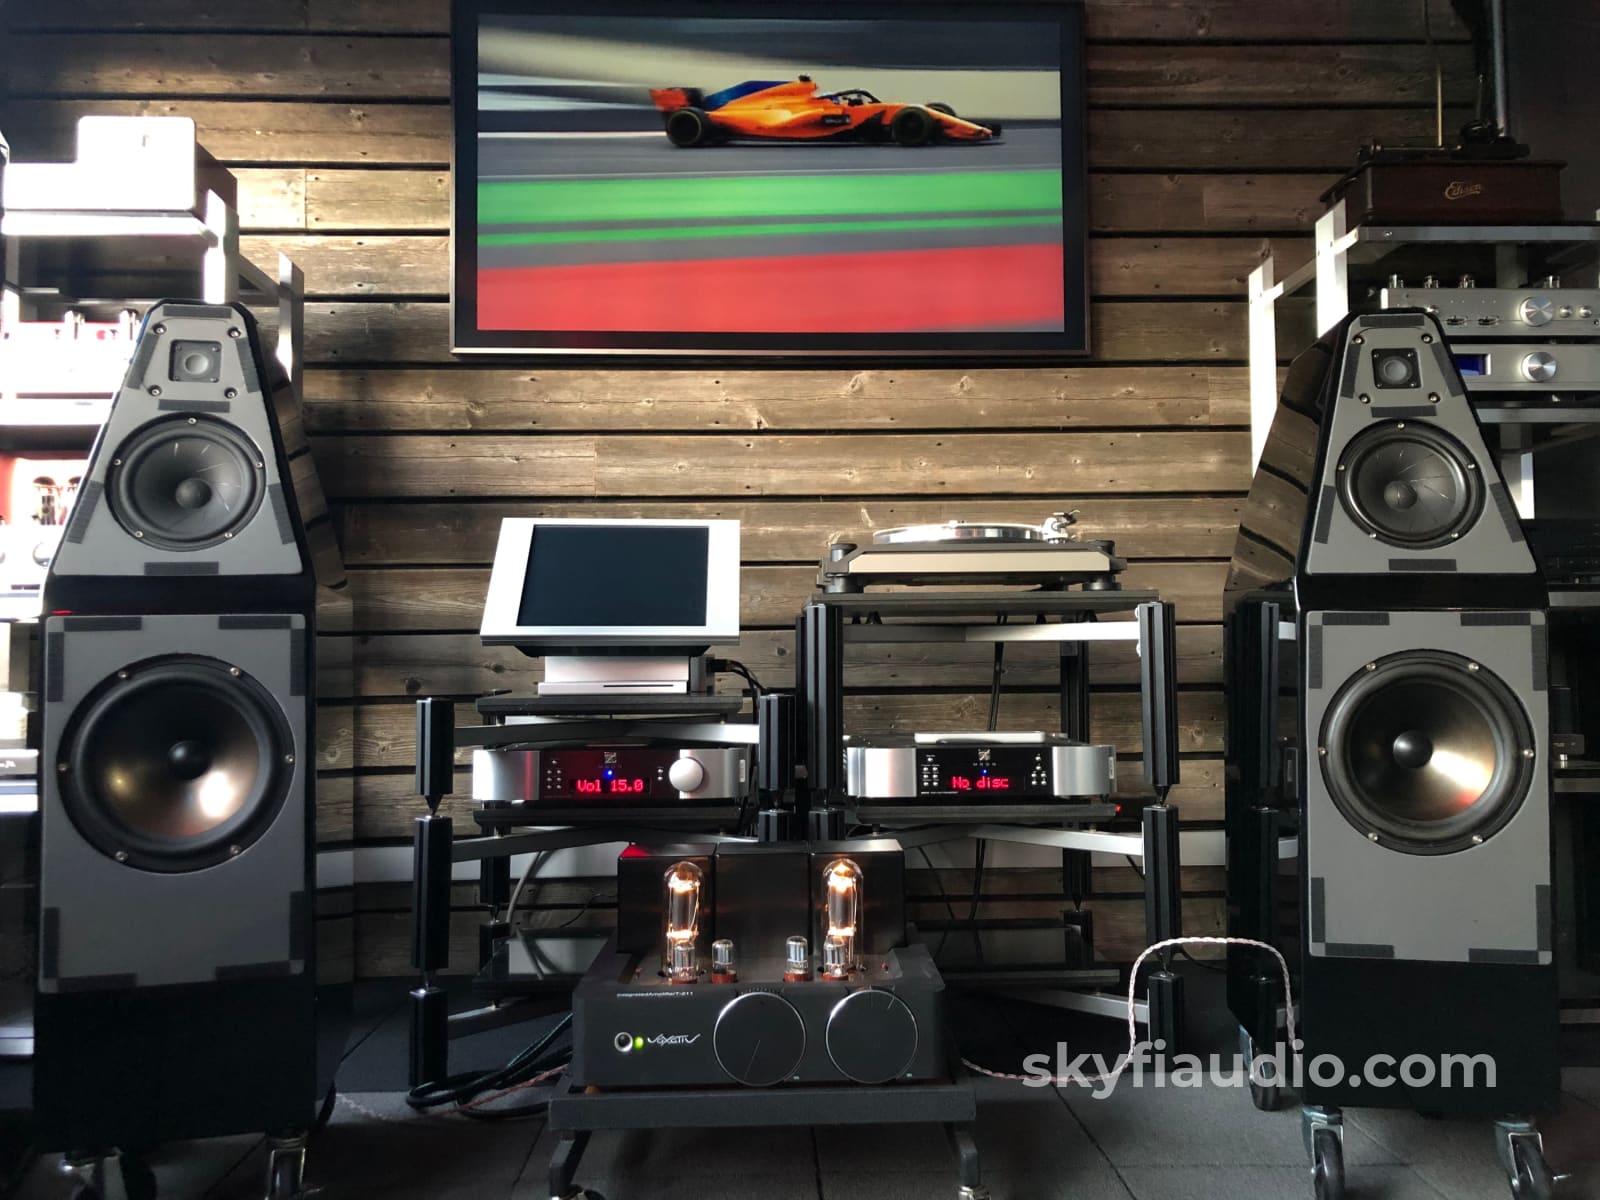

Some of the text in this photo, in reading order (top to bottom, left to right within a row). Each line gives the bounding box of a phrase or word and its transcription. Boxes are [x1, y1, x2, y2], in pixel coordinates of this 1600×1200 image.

[577, 778, 644, 792] Vol 15.0
[951, 776, 1009, 789] No disc
